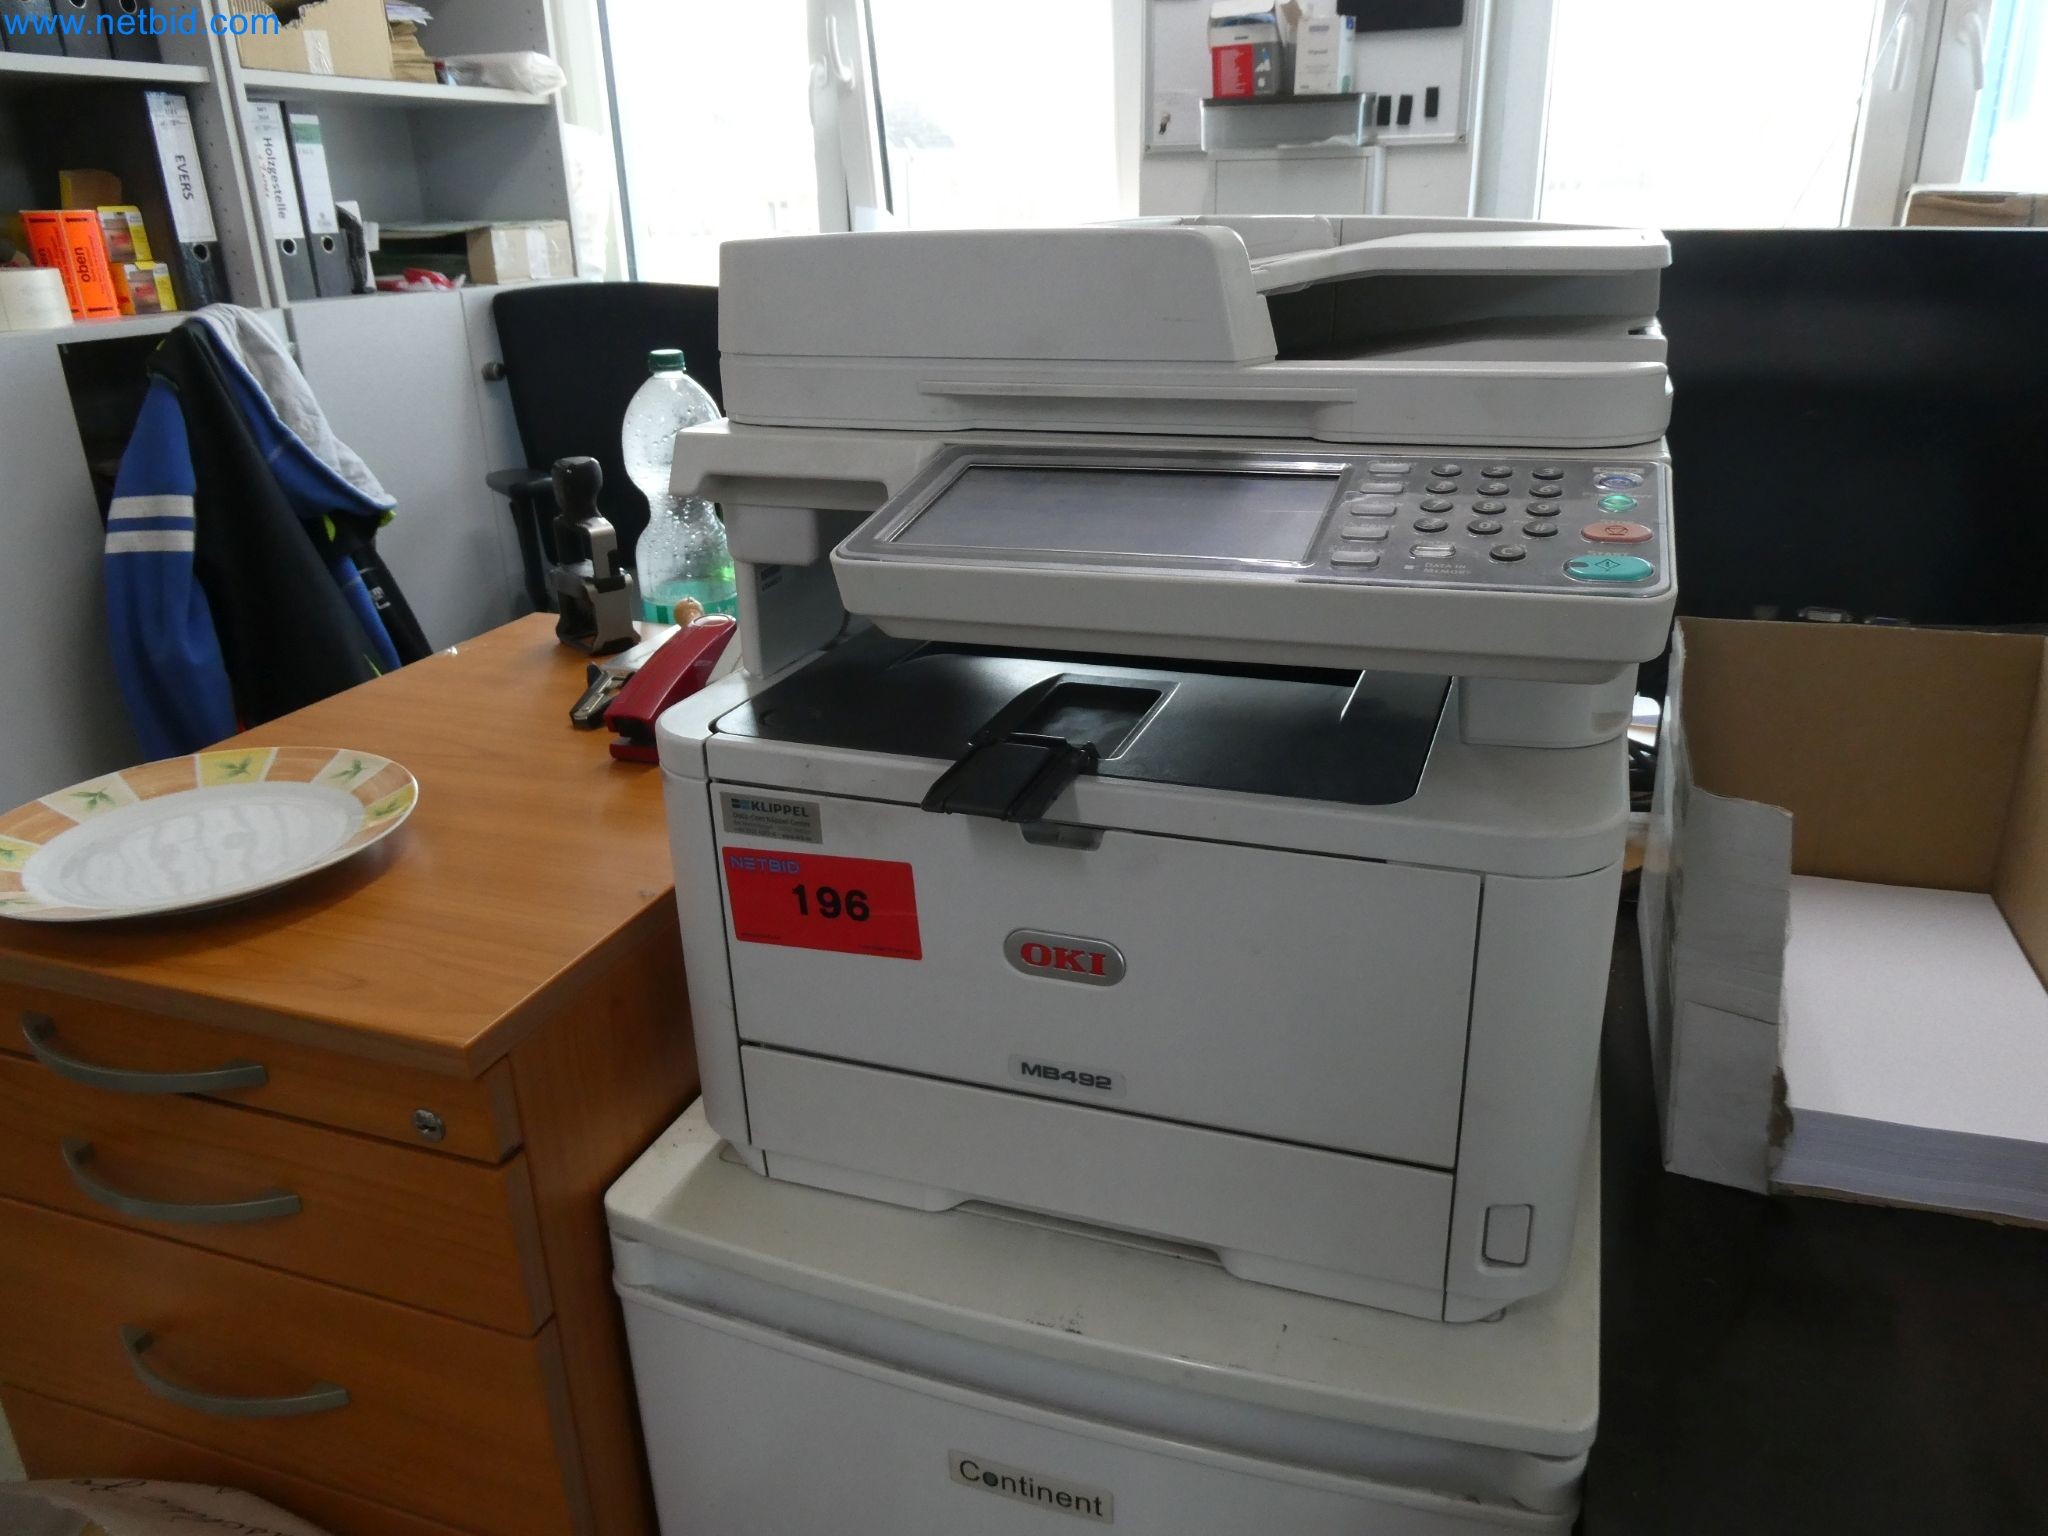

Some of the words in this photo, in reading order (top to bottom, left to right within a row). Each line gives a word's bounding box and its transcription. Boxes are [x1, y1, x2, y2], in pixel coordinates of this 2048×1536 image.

[174, 154, 194, 201] EVERS
[263, 136, 287, 220] Holzgestelle
[74, 247, 91, 283] oben
[751, 800, 810, 818] KLIPPEL
[729, 855, 801, 875] NETBID
[792, 883, 870, 922] 196
[1020, 942, 1107, 977] OKI
[1020, 1061, 1113, 1090] MB492
[959, 1459, 1104, 1517] Continent
